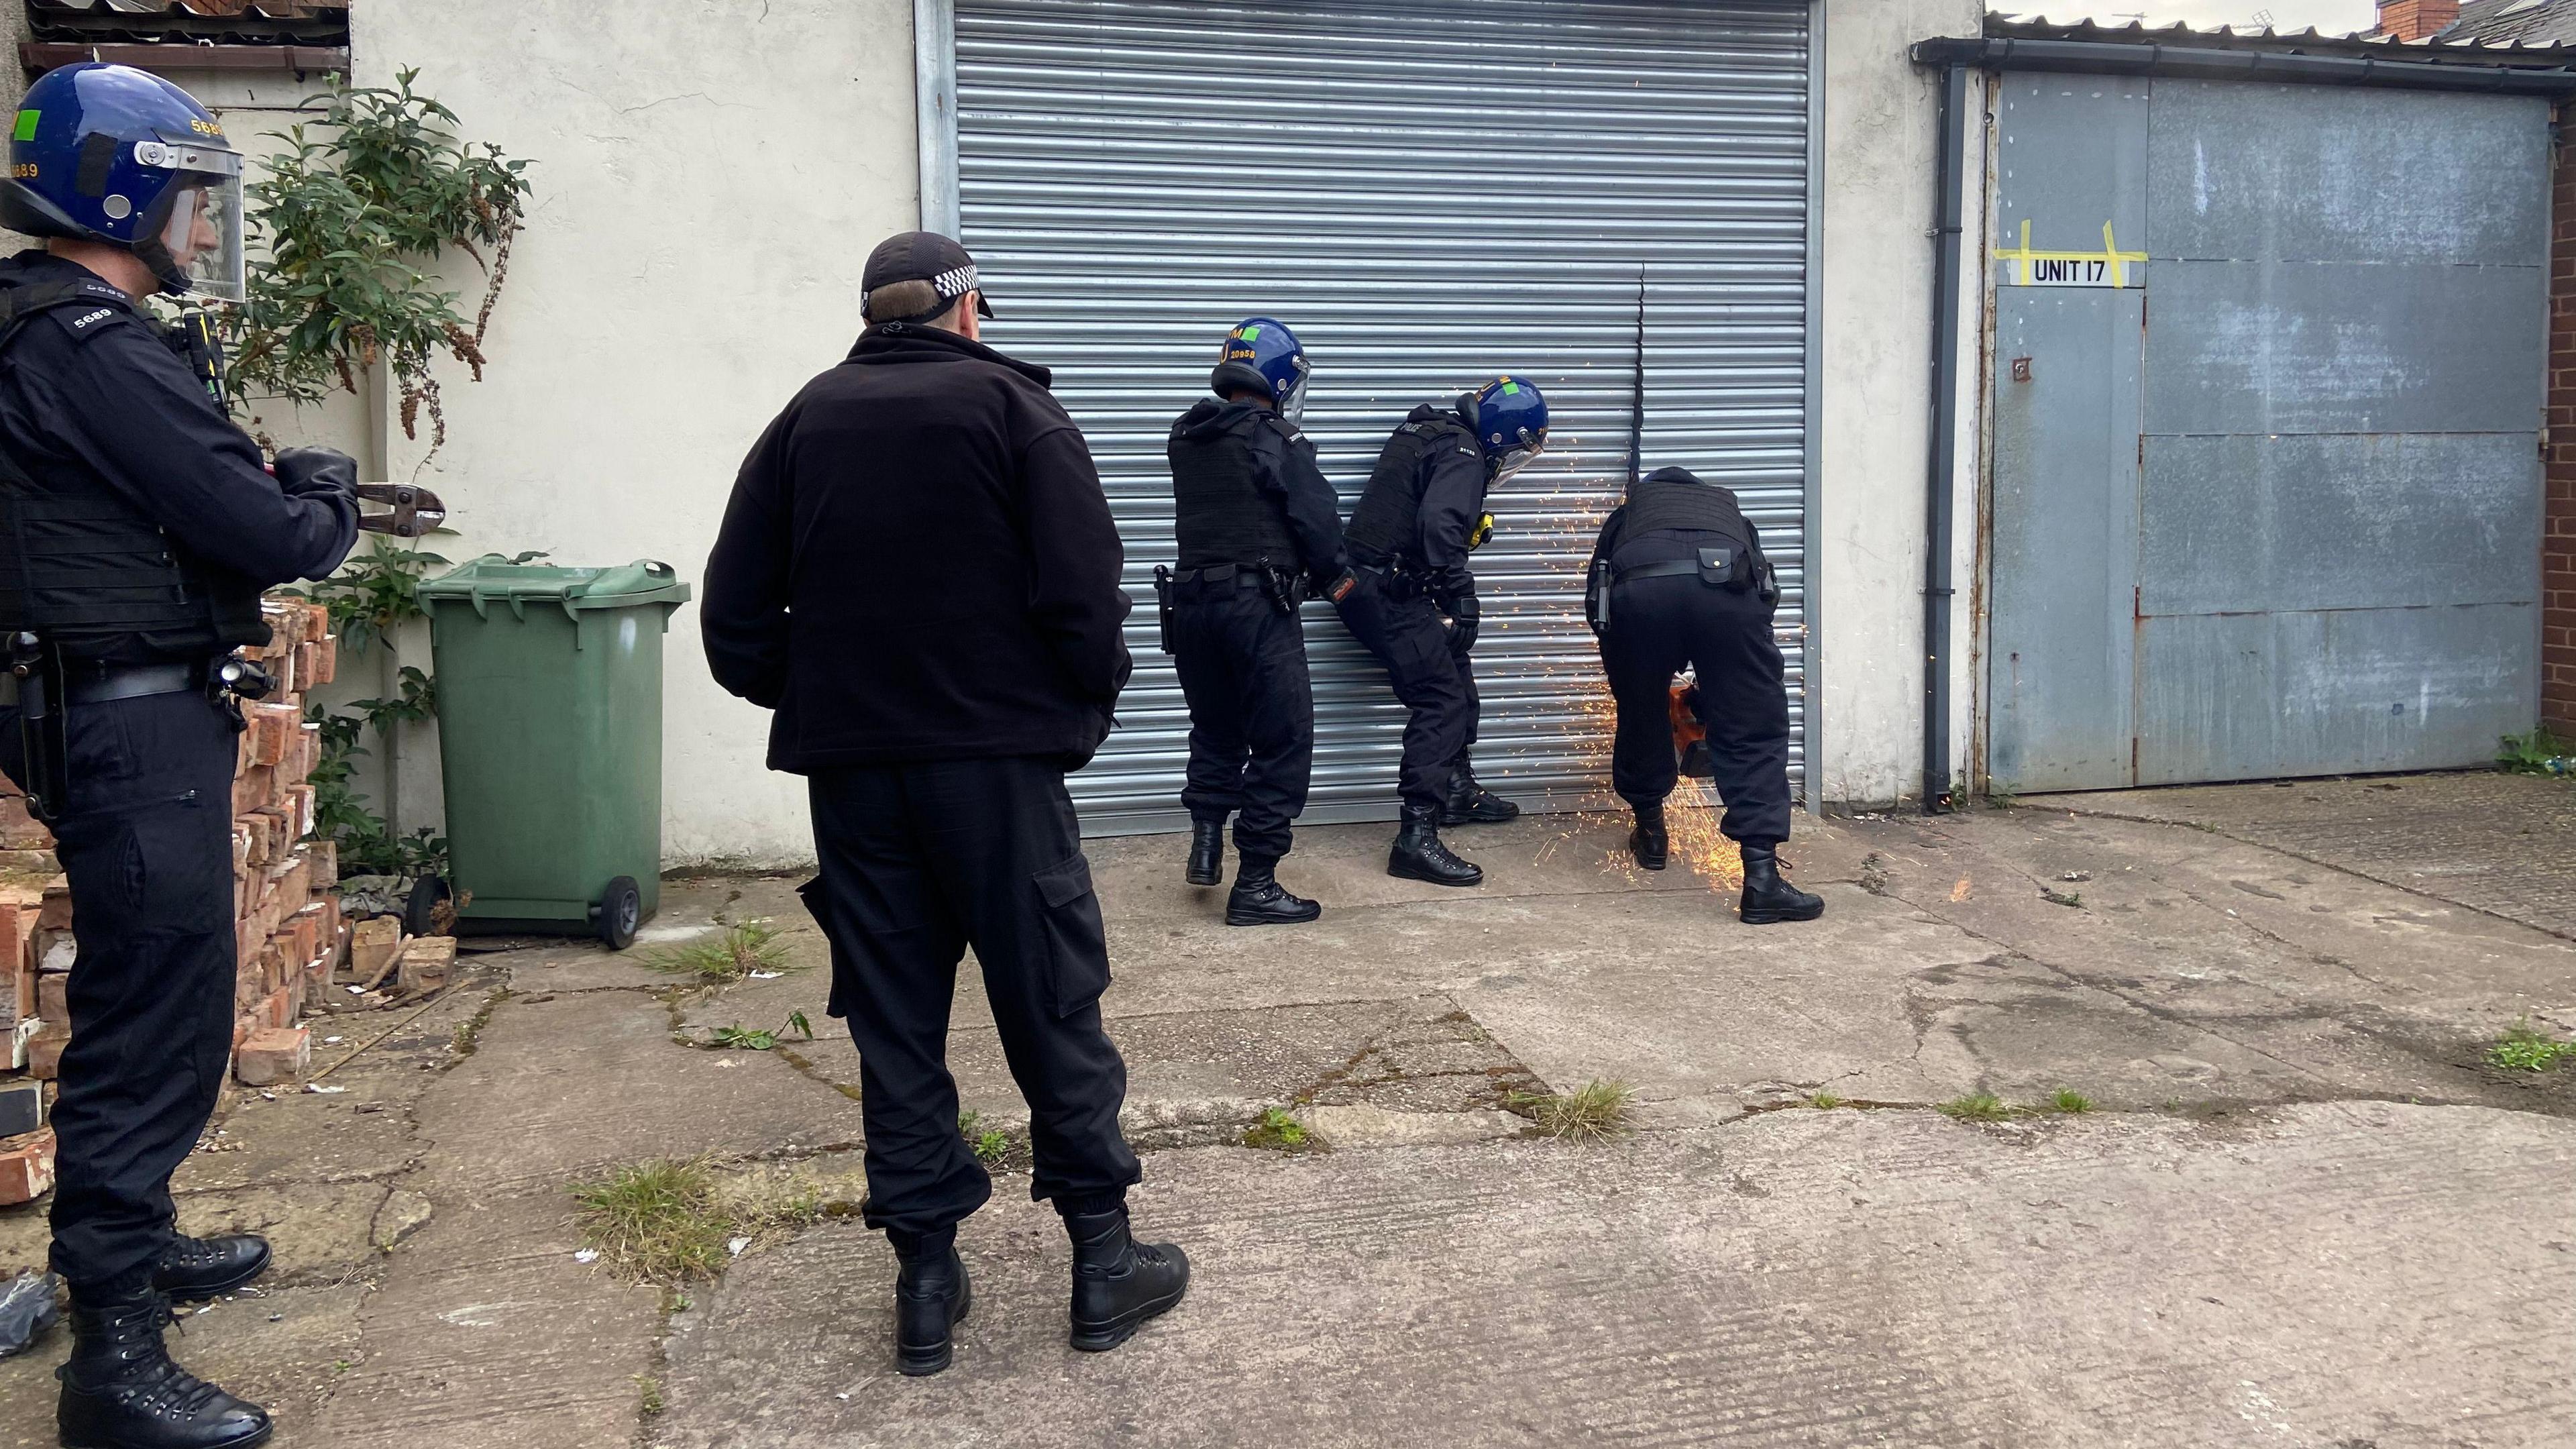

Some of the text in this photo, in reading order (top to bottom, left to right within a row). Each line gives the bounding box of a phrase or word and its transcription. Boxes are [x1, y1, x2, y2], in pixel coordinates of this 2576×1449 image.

[2035, 260, 2105, 281] UNIT 17
[74, 309, 112, 329] 5689
[1231, 350, 1256, 359] 20958
